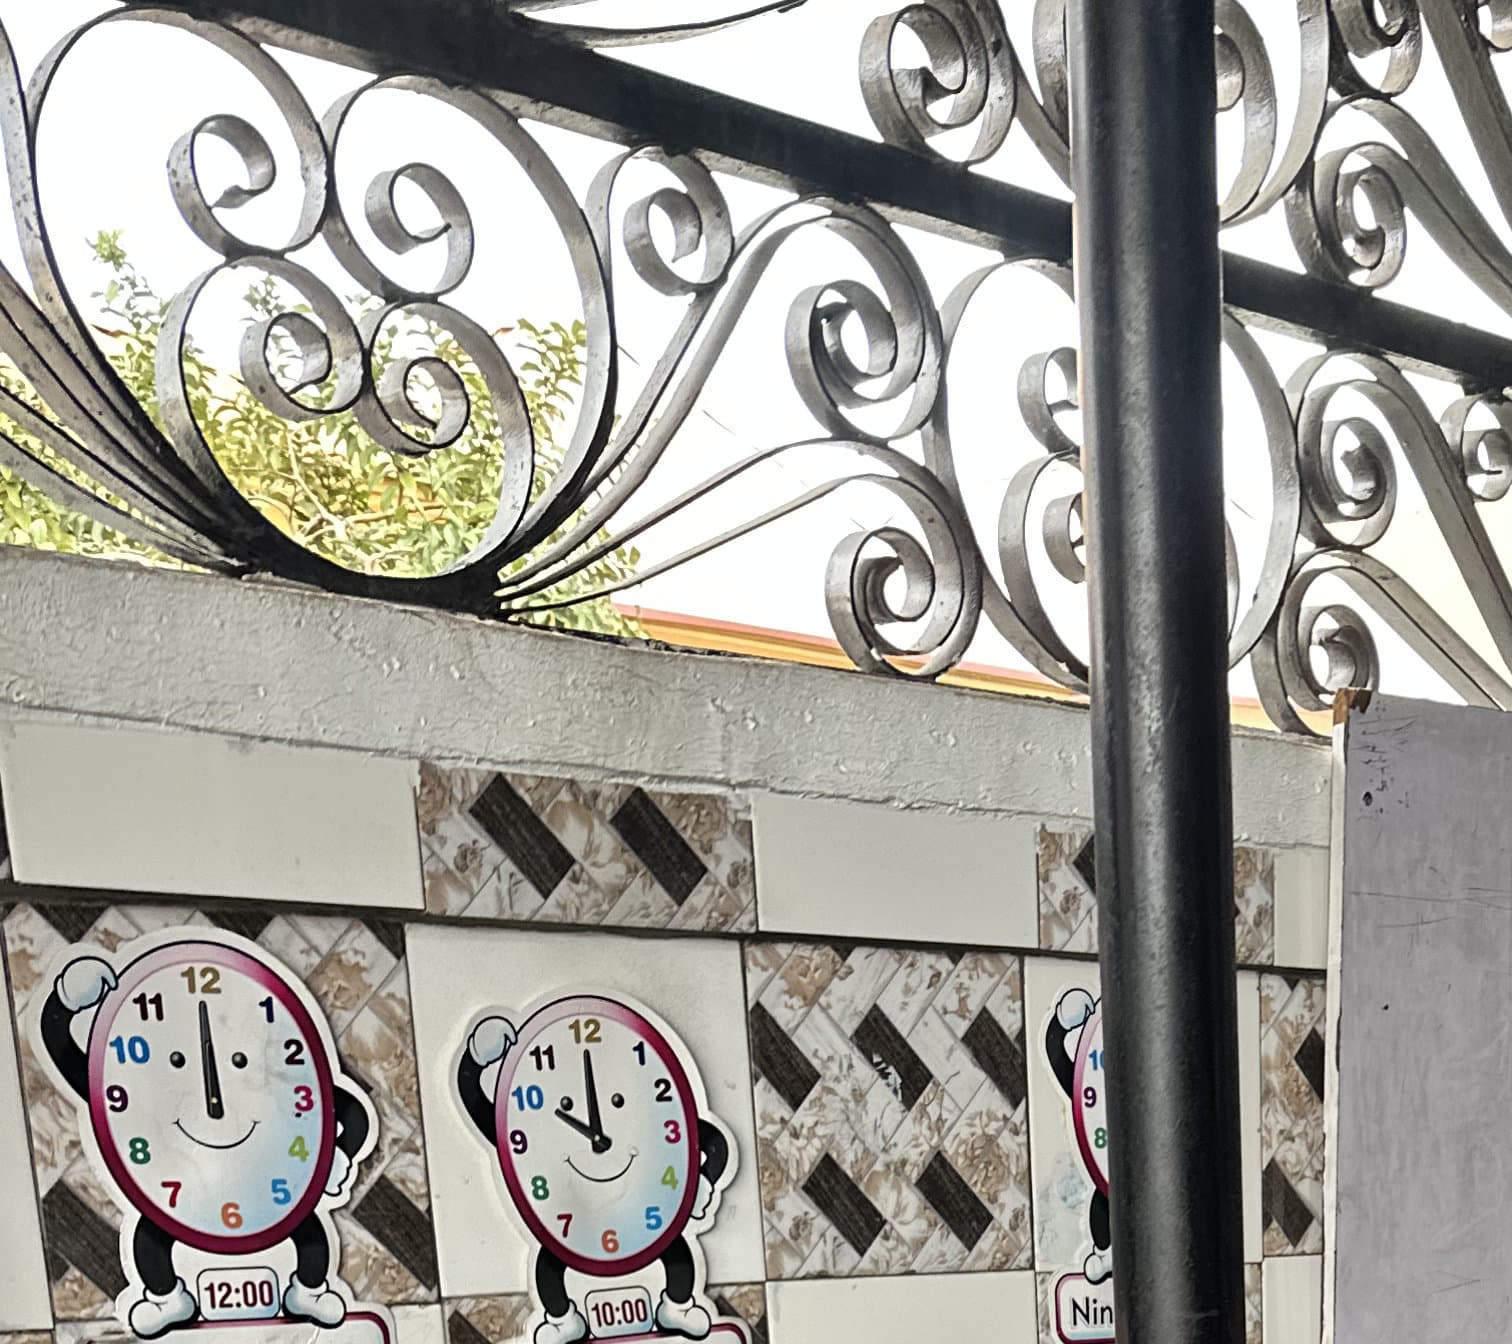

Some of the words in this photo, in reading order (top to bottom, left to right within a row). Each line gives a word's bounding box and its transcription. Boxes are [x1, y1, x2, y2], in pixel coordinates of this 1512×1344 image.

[181, 967, 221, 994] 12
[133, 993, 163, 1021] 11
[259, 996, 274, 1023] 1
[569, 1019, 601, 1044] 12
[110, 1036, 150, 1064] 10
[284, 1039, 305, 1065] 2
[530, 1045, 555, 1071] 11
[633, 1041, 645, 1066] 1
[106, 1085, 128, 1112] 9
[294, 1086, 314, 1111] 3
[512, 1085, 543, 1111] 10
[654, 1079, 672, 1102] 2
[1084, 1087, 1096, 1108] 9
[510, 1130, 527, 1154] 9
[664, 1120, 681, 1144] 3
[1094, 1128, 1106, 1148] 8
[129, 1137, 150, 1164] 8
[288, 1136, 309, 1162] 4
[531, 1176, 549, 1200] 8
[661, 1166, 678, 1190] 4
[161, 1181, 181, 1208] 7
[272, 1179, 291, 1205] 5
[221, 1202, 243, 1229] 6
[557, 1214, 572, 1238] 7
[645, 1207, 662, 1230] 5
[602, 1230, 619, 1253] 6
[205, 1280, 273, 1309] 12:00
[592, 1299, 647, 1327] 10:00
[1072, 1296, 1113, 1326] Nin
